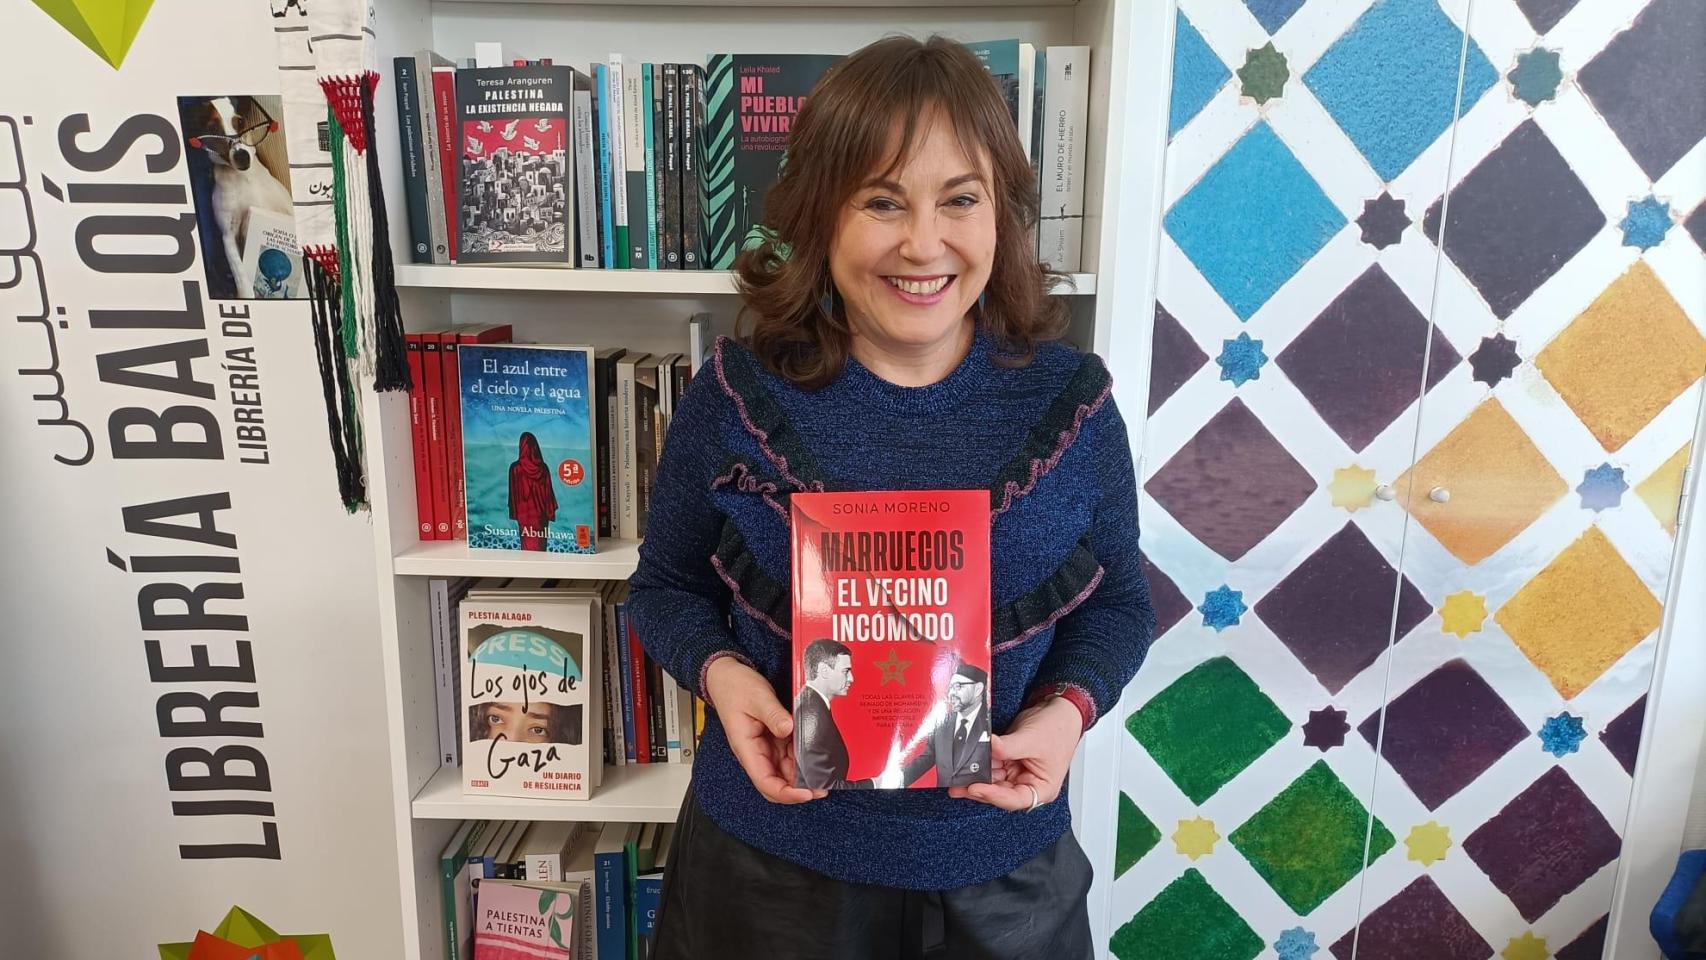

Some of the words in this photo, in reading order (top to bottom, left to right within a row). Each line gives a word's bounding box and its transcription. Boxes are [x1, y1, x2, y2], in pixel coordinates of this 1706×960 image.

[476, 79, 504, 87] Teresa
[507, 77, 552, 87] Aranguren
[741, 77, 762, 93] MI
[485, 90, 543, 100] PALESTINA
[466, 105, 476, 114] LA
[478, 104, 526, 113] EXISTENCIA
[529, 103, 563, 112] NEGADA
[741, 116, 795, 132] VIVIR
[1058, 142, 1065, 154] DE
[41, 113, 225, 459] BALQÍS
[219, 304, 254, 337] DE
[483, 359, 498, 373] El
[502, 363, 529, 376] azul
[534, 366, 568, 377] entre
[472, 380, 483, 394] el
[487, 381, 518, 395] cielo
[522, 386, 530, 400] y
[534, 382, 545, 396] el
[549, 387, 581, 401] agua
[220, 347, 270, 464] LIBRERÍA
[491, 404, 505, 413] UNA
[507, 405, 532, 414] NOVELA
[534, 406, 566, 415] PALESTINA
[564, 464, 579, 477] 5ª
[833, 503, 878, 515] SONIA
[884, 501, 950, 514] MORENO
[484, 524, 517, 537] Susan
[521, 526, 574, 540] Abulhawa
[821, 530, 964, 572] MARRUECOS
[838, 578, 861, 607] EL
[866, 577, 948, 606] VECINO
[468, 611, 500, 620] PLESTIA
[501, 612, 532, 622] ALAQAD
[832, 610, 954, 642] INCÓMODO
[472, 633, 565, 667] PRESS
[106, 492, 281, 859] LIBRERÍA
[472, 658, 503, 698] Los
[513, 665, 548, 714] ojos
[558, 657, 576, 693] de
[488, 733, 560, 779] Gaza
[543, 771, 554, 780] UN
[556, 772, 581, 780] DIARIO
[523, 781, 532, 789] DE
[534, 782, 582, 791] RESILIENCIA
[583, 877, 592, 922] LOBBYING
[486, 909, 546, 927] PALESTINA
[485, 922, 493, 931] A
[496, 924, 543, 939] TIENTAS
